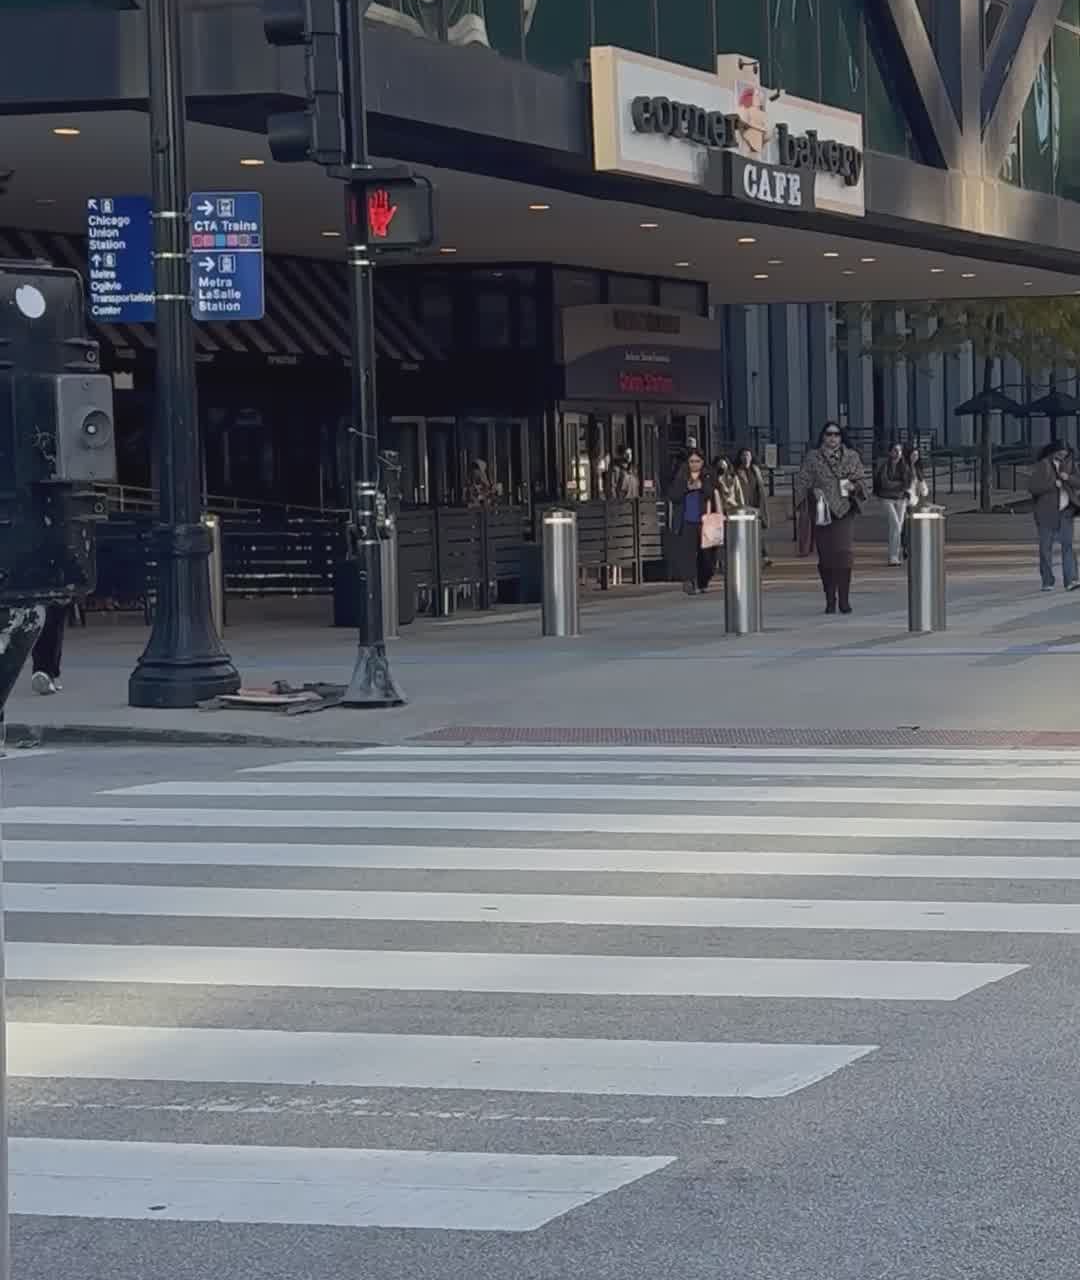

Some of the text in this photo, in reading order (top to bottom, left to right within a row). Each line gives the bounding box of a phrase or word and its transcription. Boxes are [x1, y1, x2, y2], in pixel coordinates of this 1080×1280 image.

[632, 96, 862, 186] corner bakery
[88, 215, 130, 227] Chicago
[194, 221, 258, 231] CTA Trains
[89, 228, 119, 238] Union
[89, 240, 126, 250] Station
[90, 269, 116, 279] Metra
[198, 277, 232, 287] Metra
[91, 293, 155, 304] Transportation
[199, 288, 241, 299] LaSalle
[199, 301, 241, 312] Station
